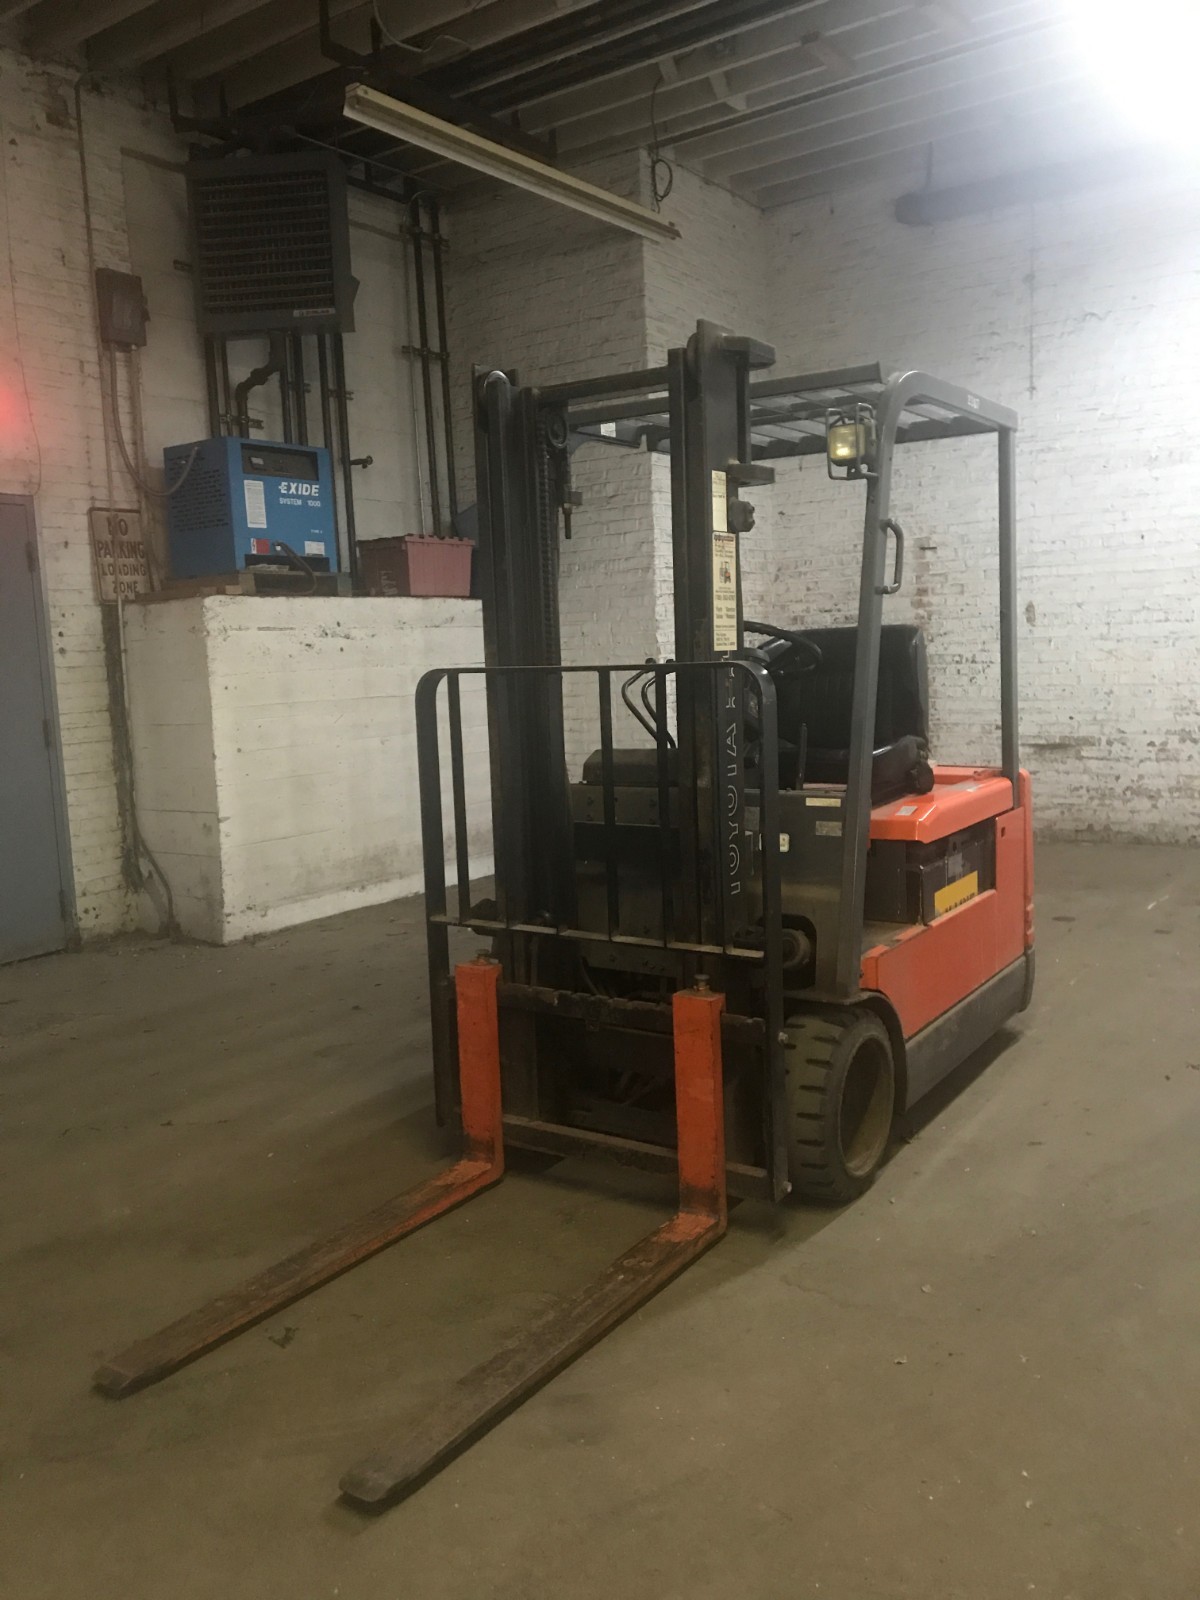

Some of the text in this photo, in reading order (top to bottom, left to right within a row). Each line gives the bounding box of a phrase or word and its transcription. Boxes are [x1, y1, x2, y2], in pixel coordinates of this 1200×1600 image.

[279, 481, 320, 497] EXIDE
[279, 497, 322, 508] SYSTEM 1000
[97, 540, 145, 559] PAKING
